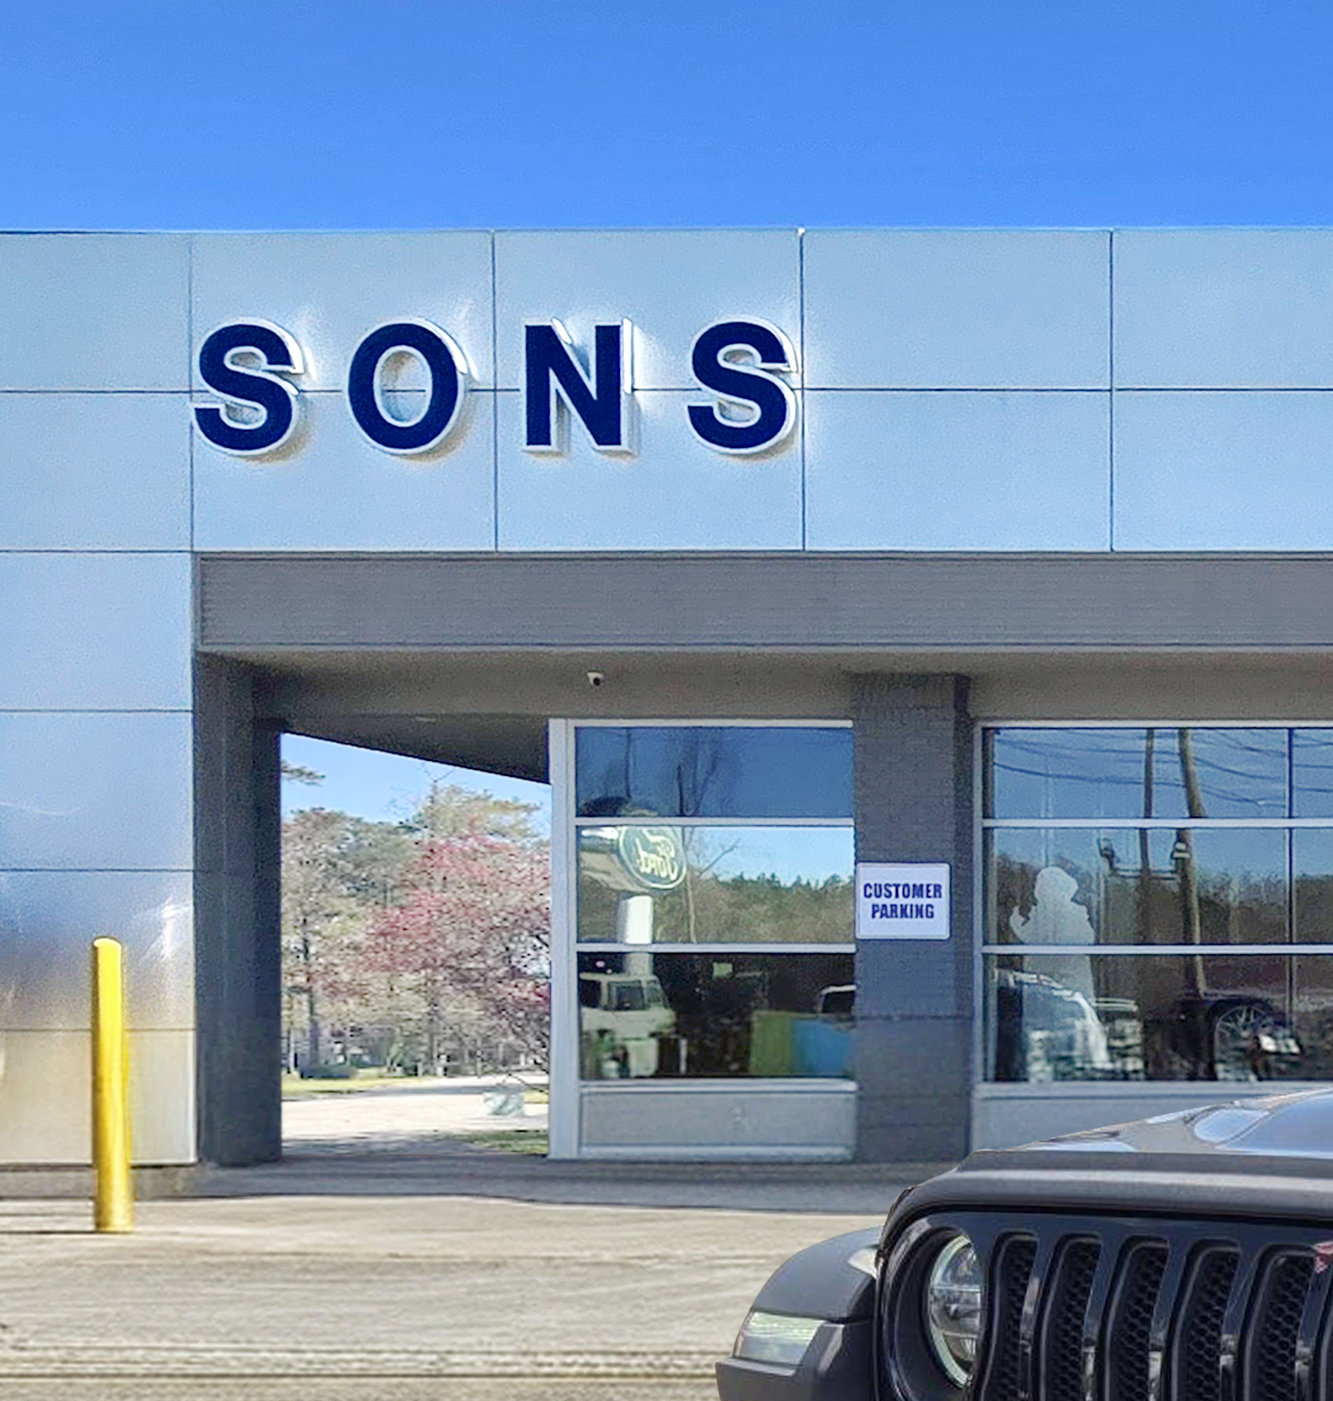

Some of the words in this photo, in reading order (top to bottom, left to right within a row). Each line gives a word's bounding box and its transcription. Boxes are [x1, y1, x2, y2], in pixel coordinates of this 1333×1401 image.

[193, 318, 802, 454] SONS
[862, 882, 943, 899] CUSTOMER
[871, 903, 935, 919] PARKING
